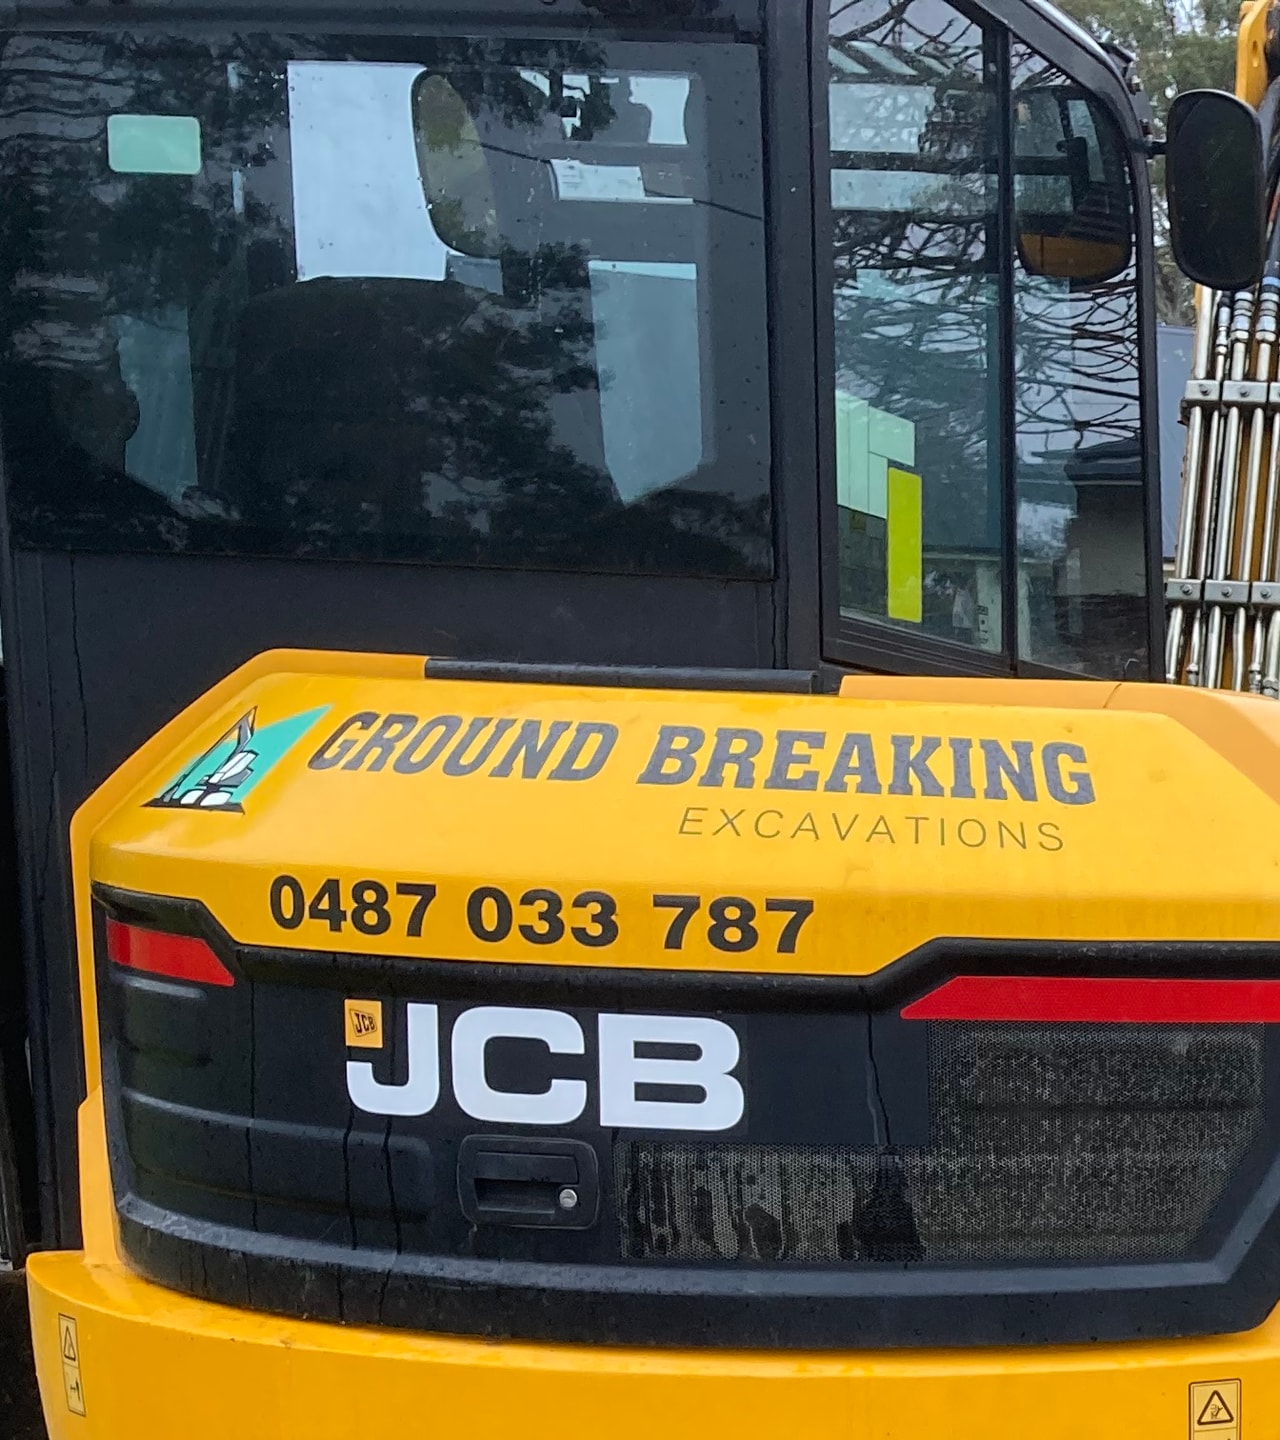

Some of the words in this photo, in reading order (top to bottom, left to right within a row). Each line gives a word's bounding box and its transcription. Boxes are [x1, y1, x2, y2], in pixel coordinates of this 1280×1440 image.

[307, 711, 619, 782] GROUND
[636, 724, 1096, 806] BREAKING
[678, 806, 1065, 852] EXCAVATIONS
[269, 874, 436, 938] 0487
[466, 885, 620, 948] 033
[652, 893, 814, 954] 787
[354, 1012, 375, 1034] JCB
[345, 1002, 746, 1132] JCB
